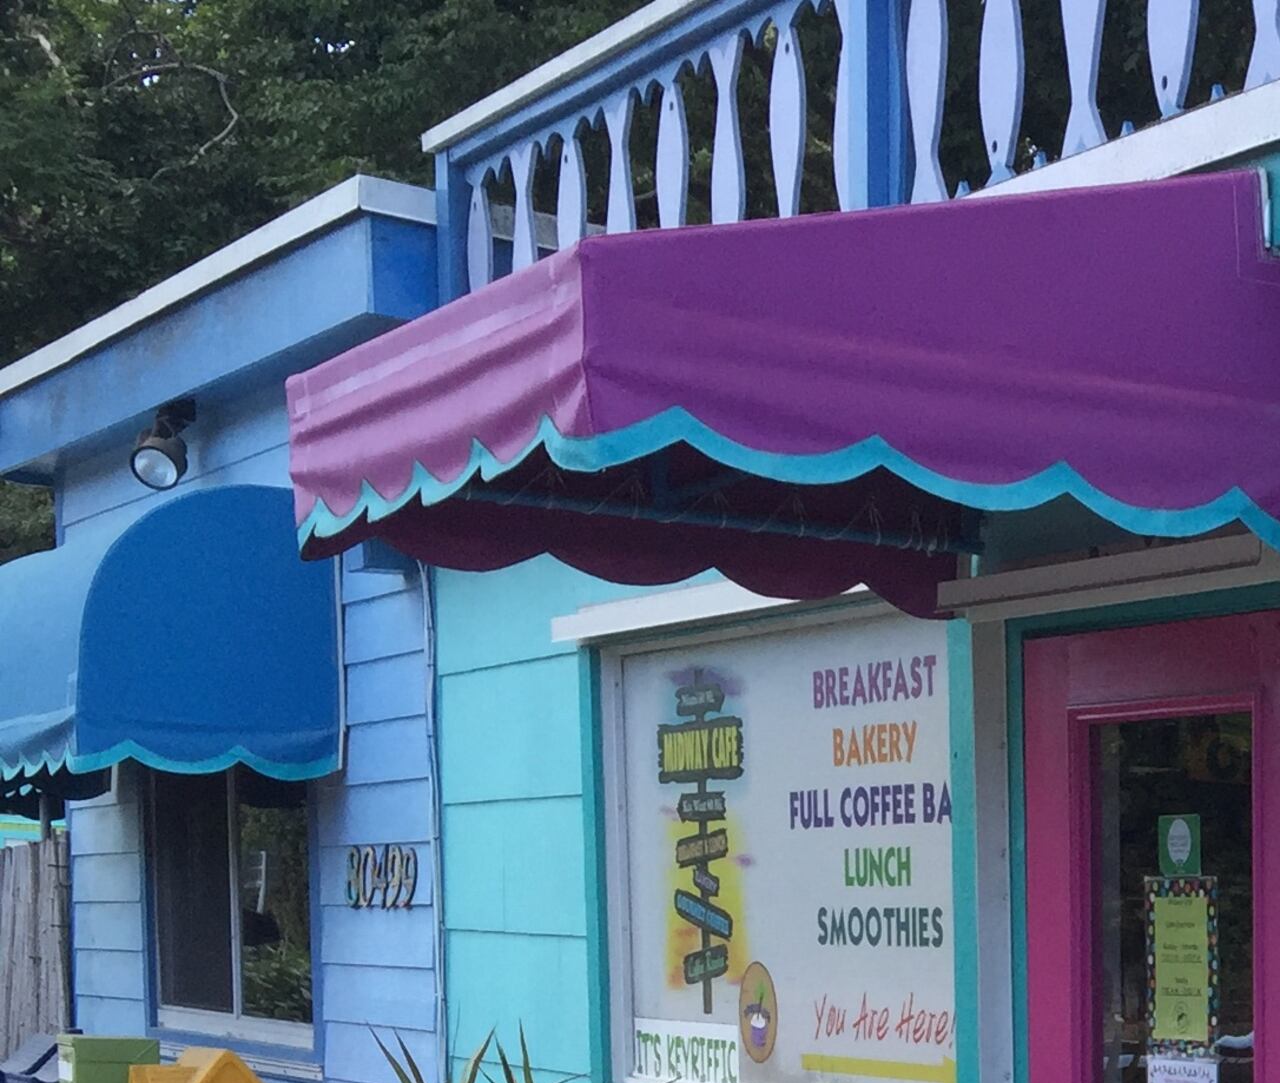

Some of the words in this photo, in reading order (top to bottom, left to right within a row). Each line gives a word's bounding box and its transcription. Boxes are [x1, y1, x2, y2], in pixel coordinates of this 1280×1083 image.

[813, 654, 937, 710] BREAKFAST
[663, 728, 708, 773] MIDWAY
[711, 725, 739, 769] CAFE
[832, 720, 918, 768] BAKERY
[789, 788, 834, 830] FULL
[840, 783, 916, 828] COFFEE
[345, 843, 418, 909] 80499
[844, 846, 912, 888] LUNCH
[817, 906, 944, 949] SMOOTHIES
[814, 993, 847, 1041] You
[853, 992, 890, 1042] Are
[636, 1029, 662, 1078] IT'S
